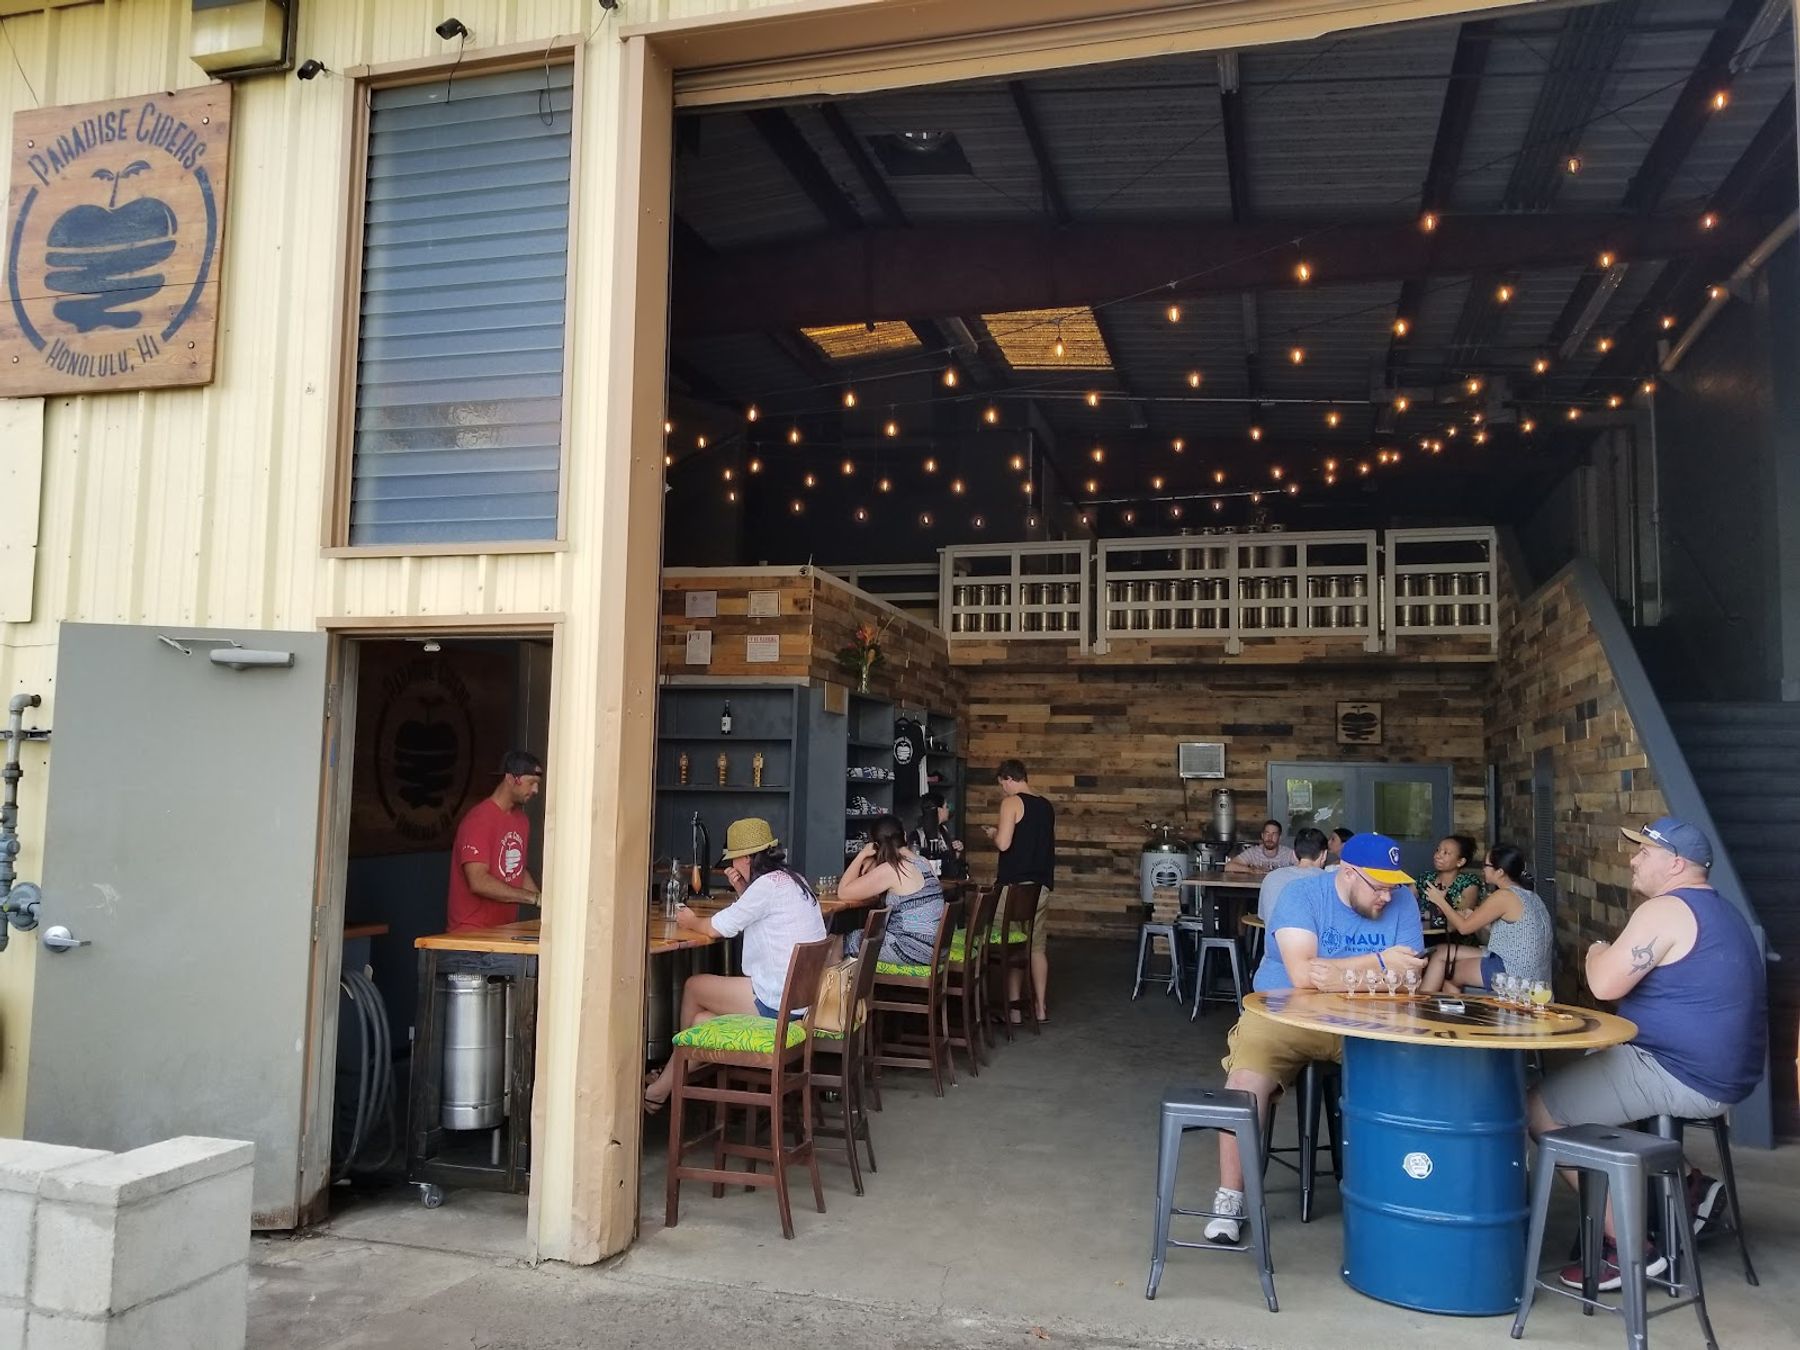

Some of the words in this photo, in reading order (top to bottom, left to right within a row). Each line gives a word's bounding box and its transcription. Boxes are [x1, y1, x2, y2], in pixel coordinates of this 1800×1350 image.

[27, 109, 131, 186] PARADISE
[136, 102, 207, 169] CIDERS
[46, 338, 135, 377] HONOLULU,
[139, 334, 160, 362] HI
[1345, 933, 1386, 946] MAUI
